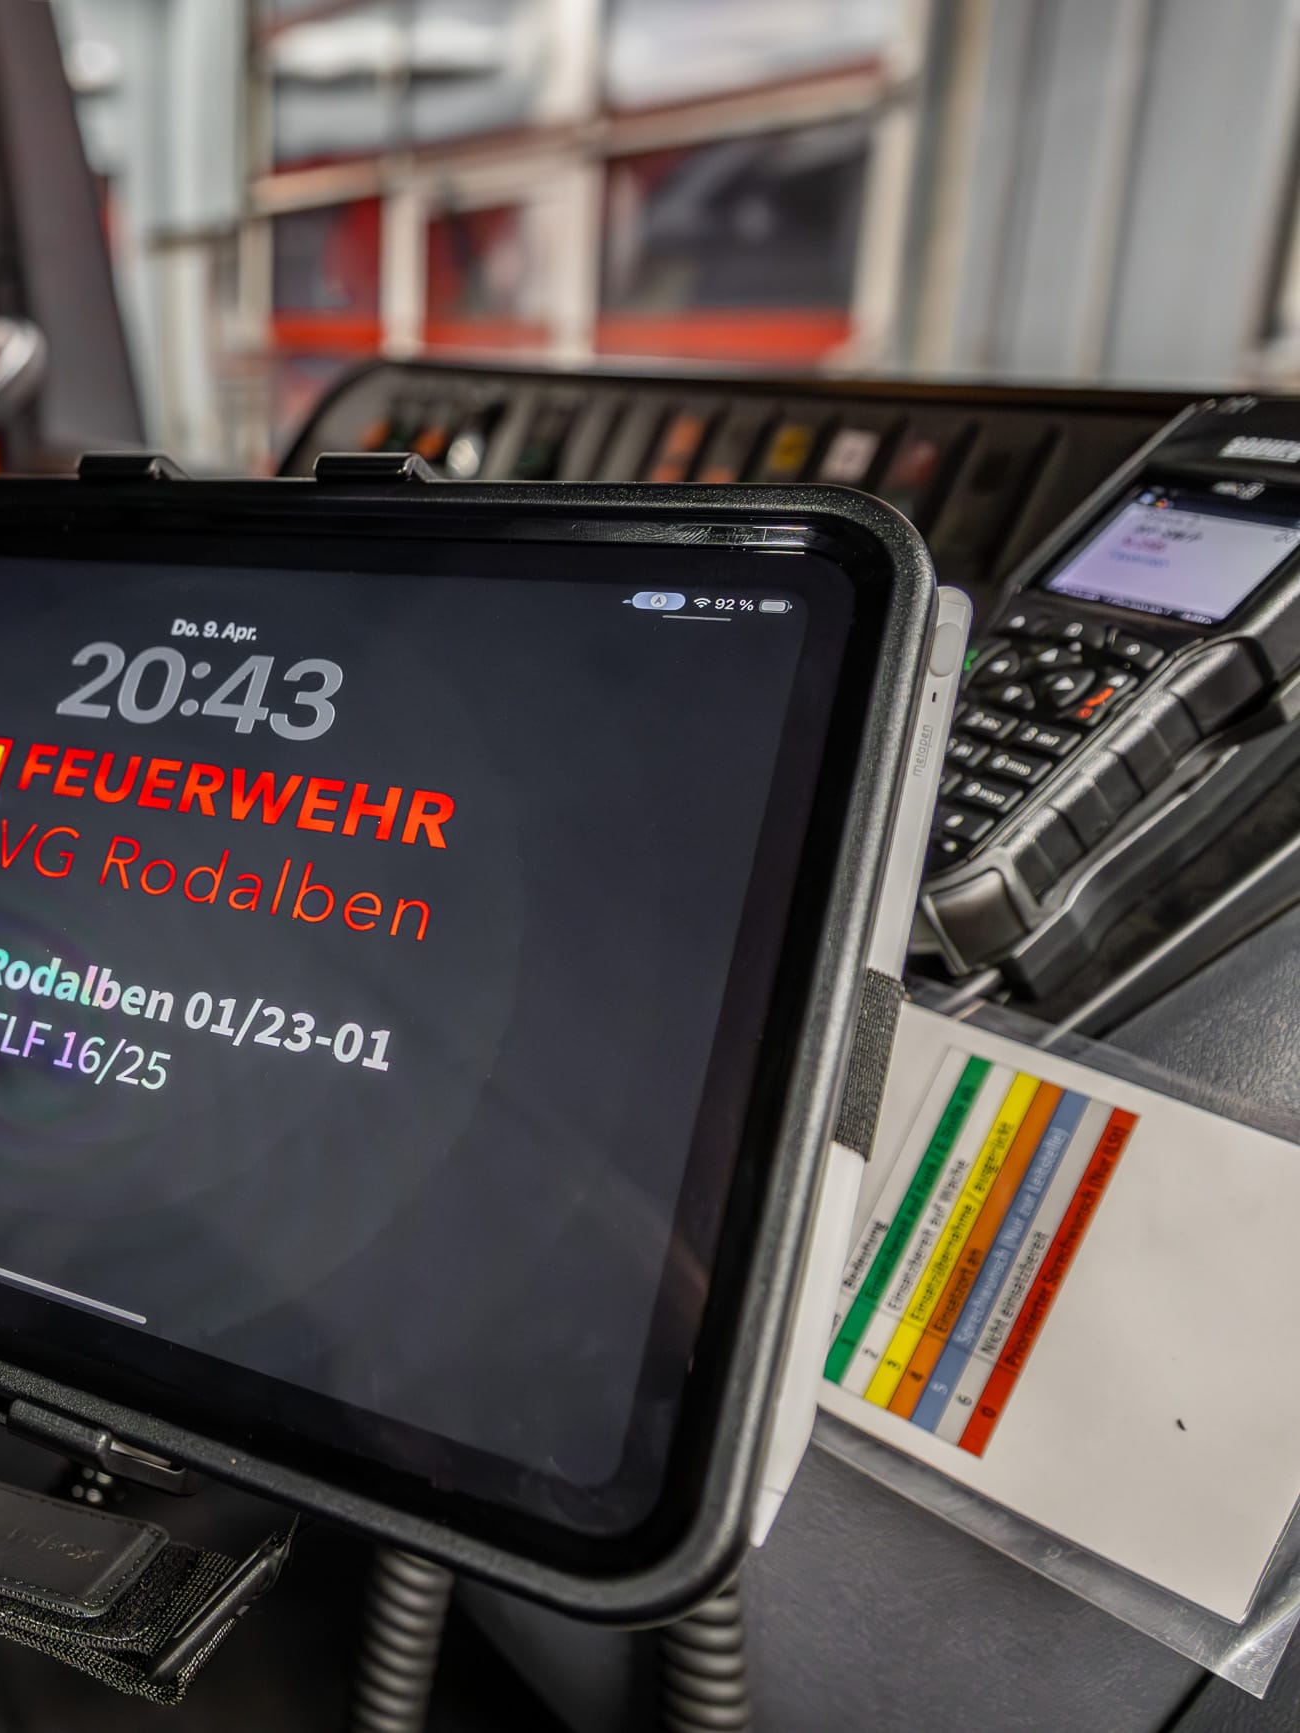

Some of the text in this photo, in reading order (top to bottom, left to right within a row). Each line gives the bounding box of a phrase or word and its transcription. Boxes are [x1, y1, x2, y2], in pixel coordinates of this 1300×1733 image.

[171, 618, 257, 642] Do. 9. Apr.
[714, 598, 754, 611] 92 %
[55, 641, 344, 740] 20:43
[17, 743, 455, 849] FEUERWEHR
[0, 818, 432, 941] VG Rodalben
[53, 1030, 171, 1091] 16/25
[184, 990, 392, 1072] 01/23-01
[842, 1218, 888, 1291] Bedeutung
[886, 1226, 938, 1312] Einsatzbereit
[926, 1203, 948, 1228] auf
[907, 1201, 978, 1323] Einsatzübernahme
[931, 1246, 984, 1334] Einsatzort an
[951, 1244, 1015, 1347] Sprechwunsch
[1015, 1192, 1039, 1220] zur
[978, 1228, 1052, 1356] Nicht einsatzbereit
[1002, 1285, 1055, 1368] Priorisierter
[1039, 1187, 1101, 1288] Sprechwunsch
[862, 1347, 879, 1360] 2
[885, 1358, 902, 1371] 3
[907, 1368, 925, 1383] 4
[928, 1378, 950, 1396] 5
[954, 1391, 974, 1408] 6
[978, 1403, 998, 1421] 0
